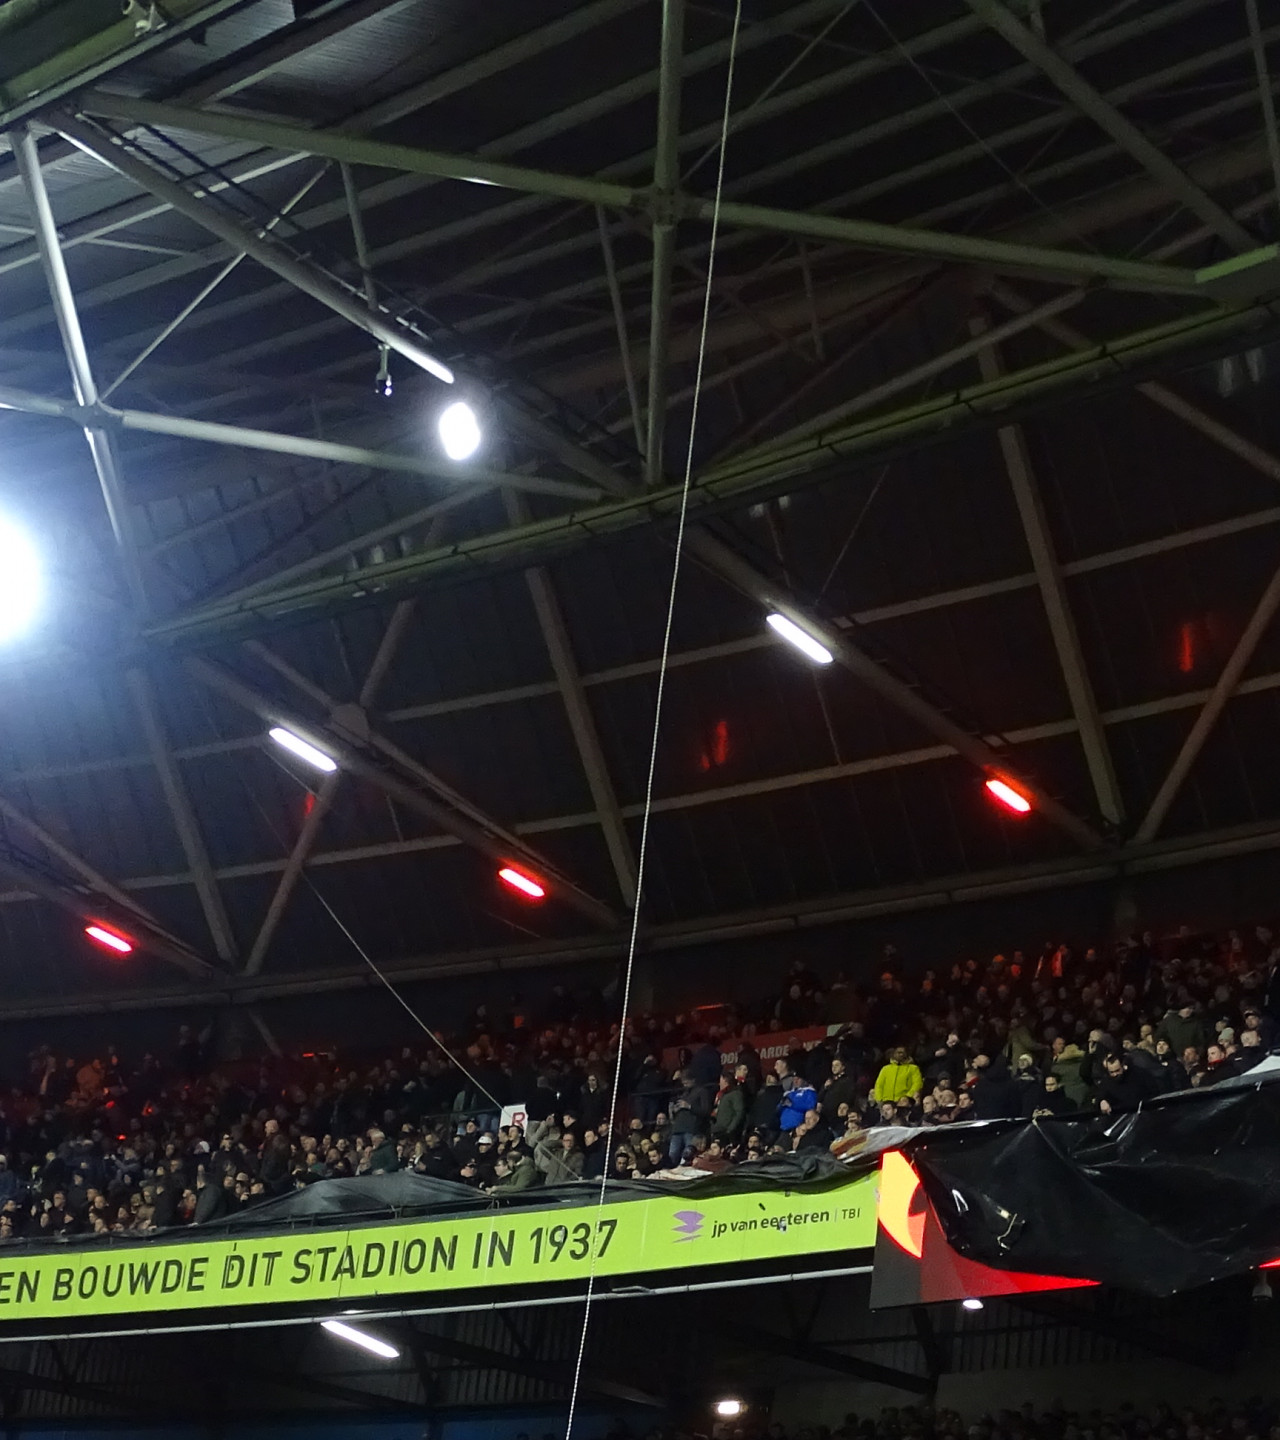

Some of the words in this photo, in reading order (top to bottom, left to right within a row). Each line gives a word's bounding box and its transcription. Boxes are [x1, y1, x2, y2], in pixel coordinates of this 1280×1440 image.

[711, 1220, 728, 1239] jp
[731, 1218, 758, 1231] van
[842, 1208, 862, 1220] TBI
[52, 1257, 210, 1301] BOUWDE
[221, 1250, 282, 1290] DIT
[289, 1234, 459, 1285] STADION
[471, 1230, 516, 1270] IN
[529, 1219, 618, 1265] 1937
